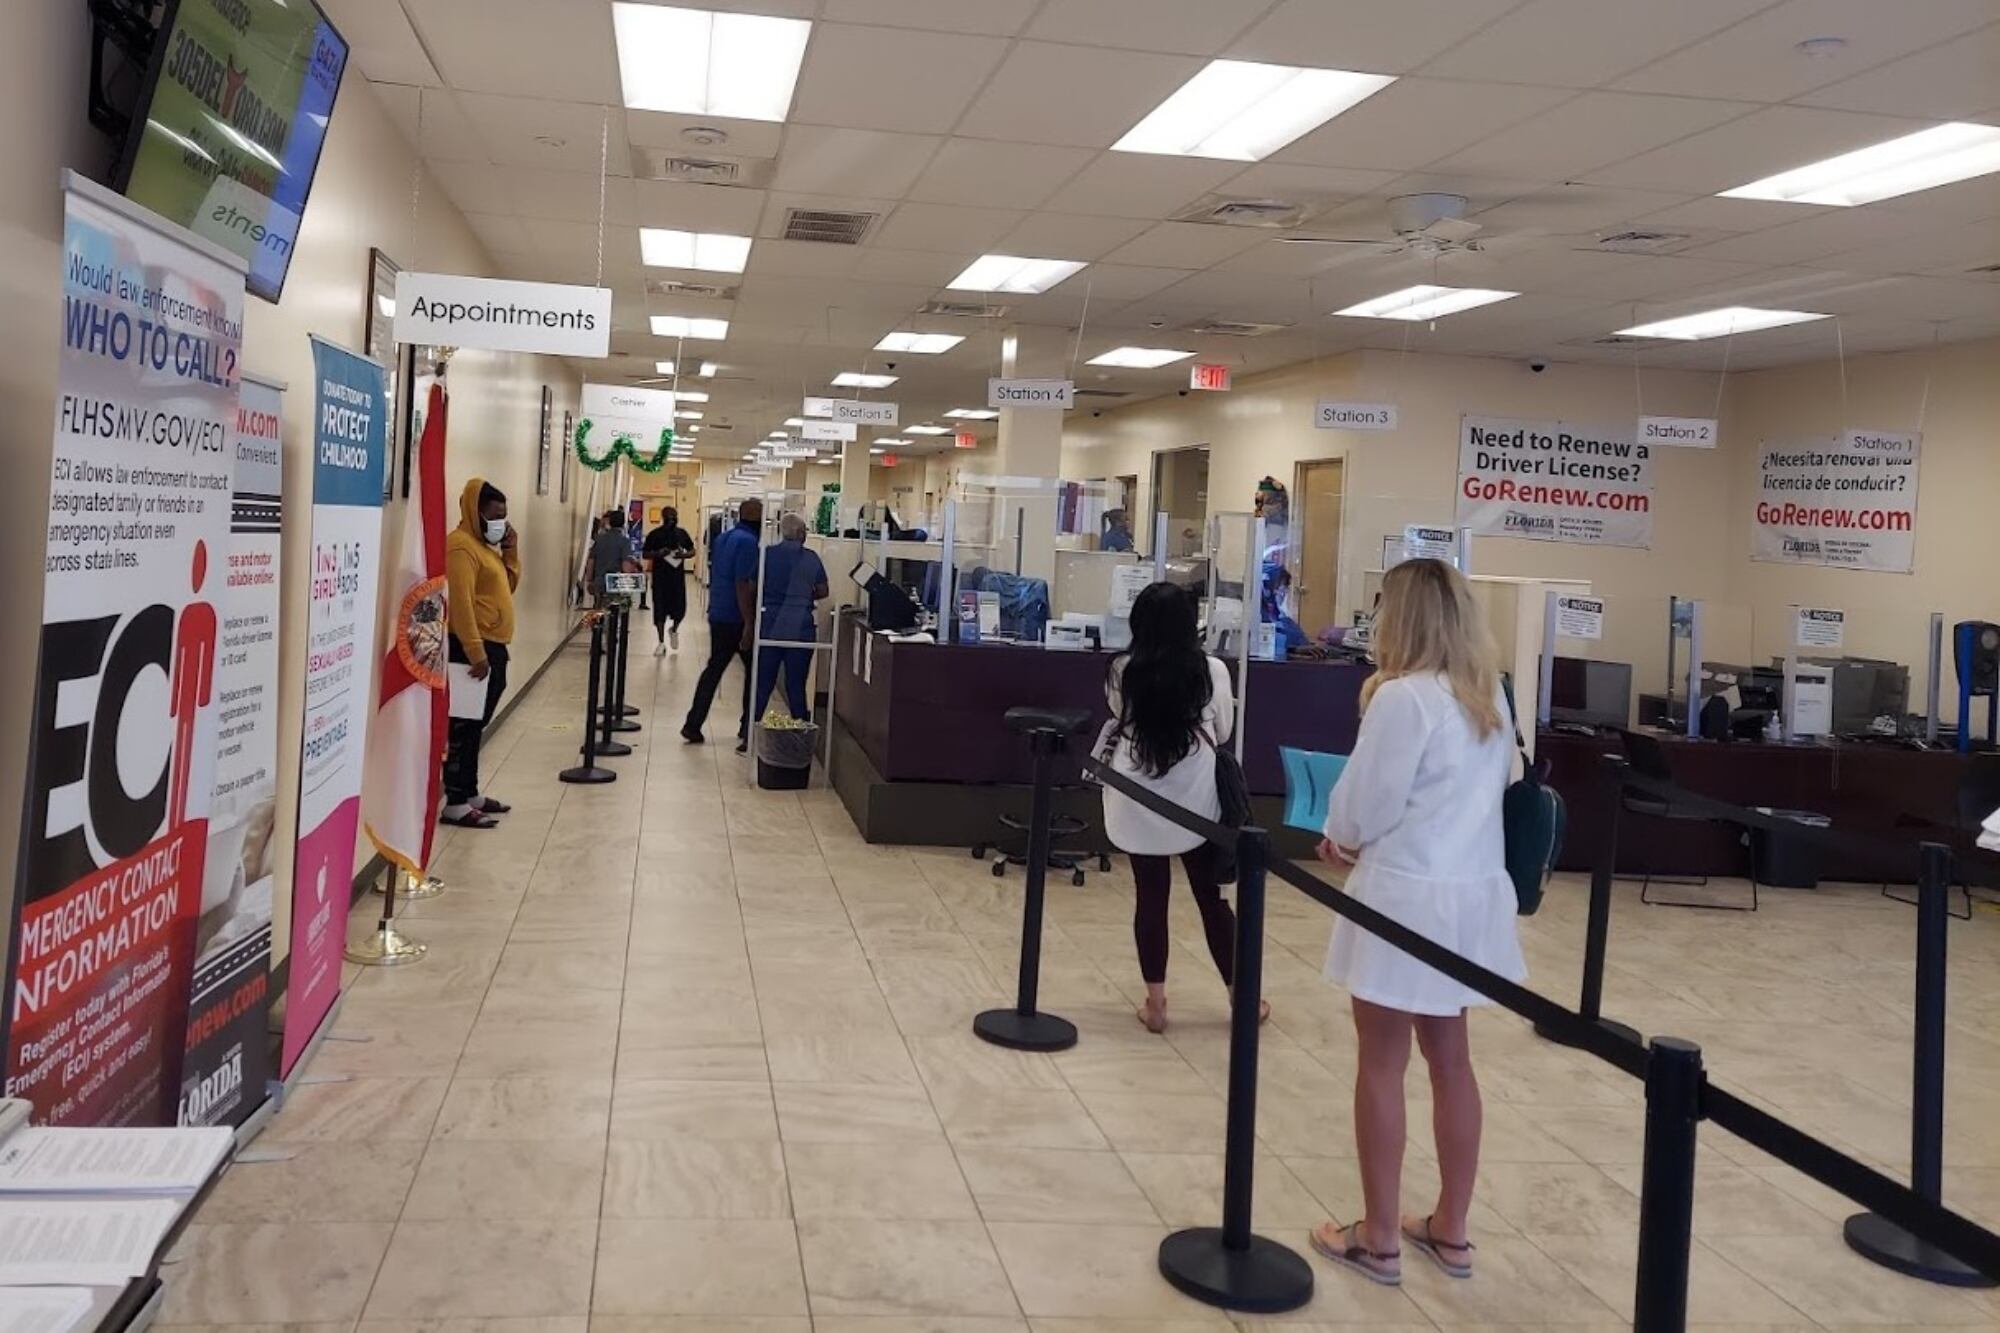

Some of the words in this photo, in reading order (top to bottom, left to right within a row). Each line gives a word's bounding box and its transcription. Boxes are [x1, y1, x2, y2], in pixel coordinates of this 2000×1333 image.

[69, 251, 112, 294] Would
[117, 271, 142, 300] law
[143, 287, 212, 330] enforcement
[410, 296, 595, 330] Appointments
[66, 296, 131, 360] WHO
[138, 320, 169, 370] TO
[175, 332, 236, 387] CALL?
[997, 386, 1050, 401] Station
[1054, 387, 1064, 401] 4
[61, 396, 225, 456] FLHSMV.GOV/ECI
[322, 402, 370, 442] PROTECT
[839, 406, 880, 419] Station
[884, 410, 892, 419] 5
[1323, 408, 1375, 424] Station
[1380, 411, 1388, 423] 3
[1471, 427, 1524, 449] Need
[1530, 432, 1553, 450] to
[1558, 434, 1630, 458] Renew
[1637, 445, 1649, 459] a
[1646, 424, 1695, 439] Station
[1700, 427, 1709, 439] 2
[1854, 436, 1901, 451] Station
[320, 440, 367, 470] CHILDHOOD
[1477, 452, 1544, 474] Driver
[1549, 457, 1641, 482] License?
[1762, 450, 1824, 470] ¿Necesita
[1825, 454, 1880, 466] renovar
[55, 457, 71, 480] ECI
[73, 461, 113, 483] allows
[116, 464, 129, 483] law
[132, 466, 188, 488] enforcement
[198, 473, 228, 489] contact
[1763, 474, 1813, 491] licencia
[1815, 474, 1830, 490] de
[1834, 475, 1905, 492] conducir?
[116, 491, 142, 517] family
[144, 500, 156, 512] or
[157, 494, 186, 513] friends
[1463, 477, 1649, 513] GoRenew.com
[113, 521, 152, 540] situation
[155, 525, 175, 538] even
[1505, 516, 1554, 529] FLORIDA
[1757, 502, 1912, 531] GoRenew.com
[114, 550, 139, 568] lines.
[1571, 601, 1600, 612] NOTICE
[1813, 611, 1842, 622] NOTICE
[121, 836, 183, 906] CONTACT
[20, 1016, 72, 1066] Register
[75, 993, 107, 1023] today
[108, 975, 131, 1004] with
[4, 1043, 76, 1099] Emergency
[78, 1003, 121, 1044] Contact
[62, 1048, 90, 1088] (ECI)
[78, 1071, 107, 1102] quick
[108, 1053, 127, 1077] and
